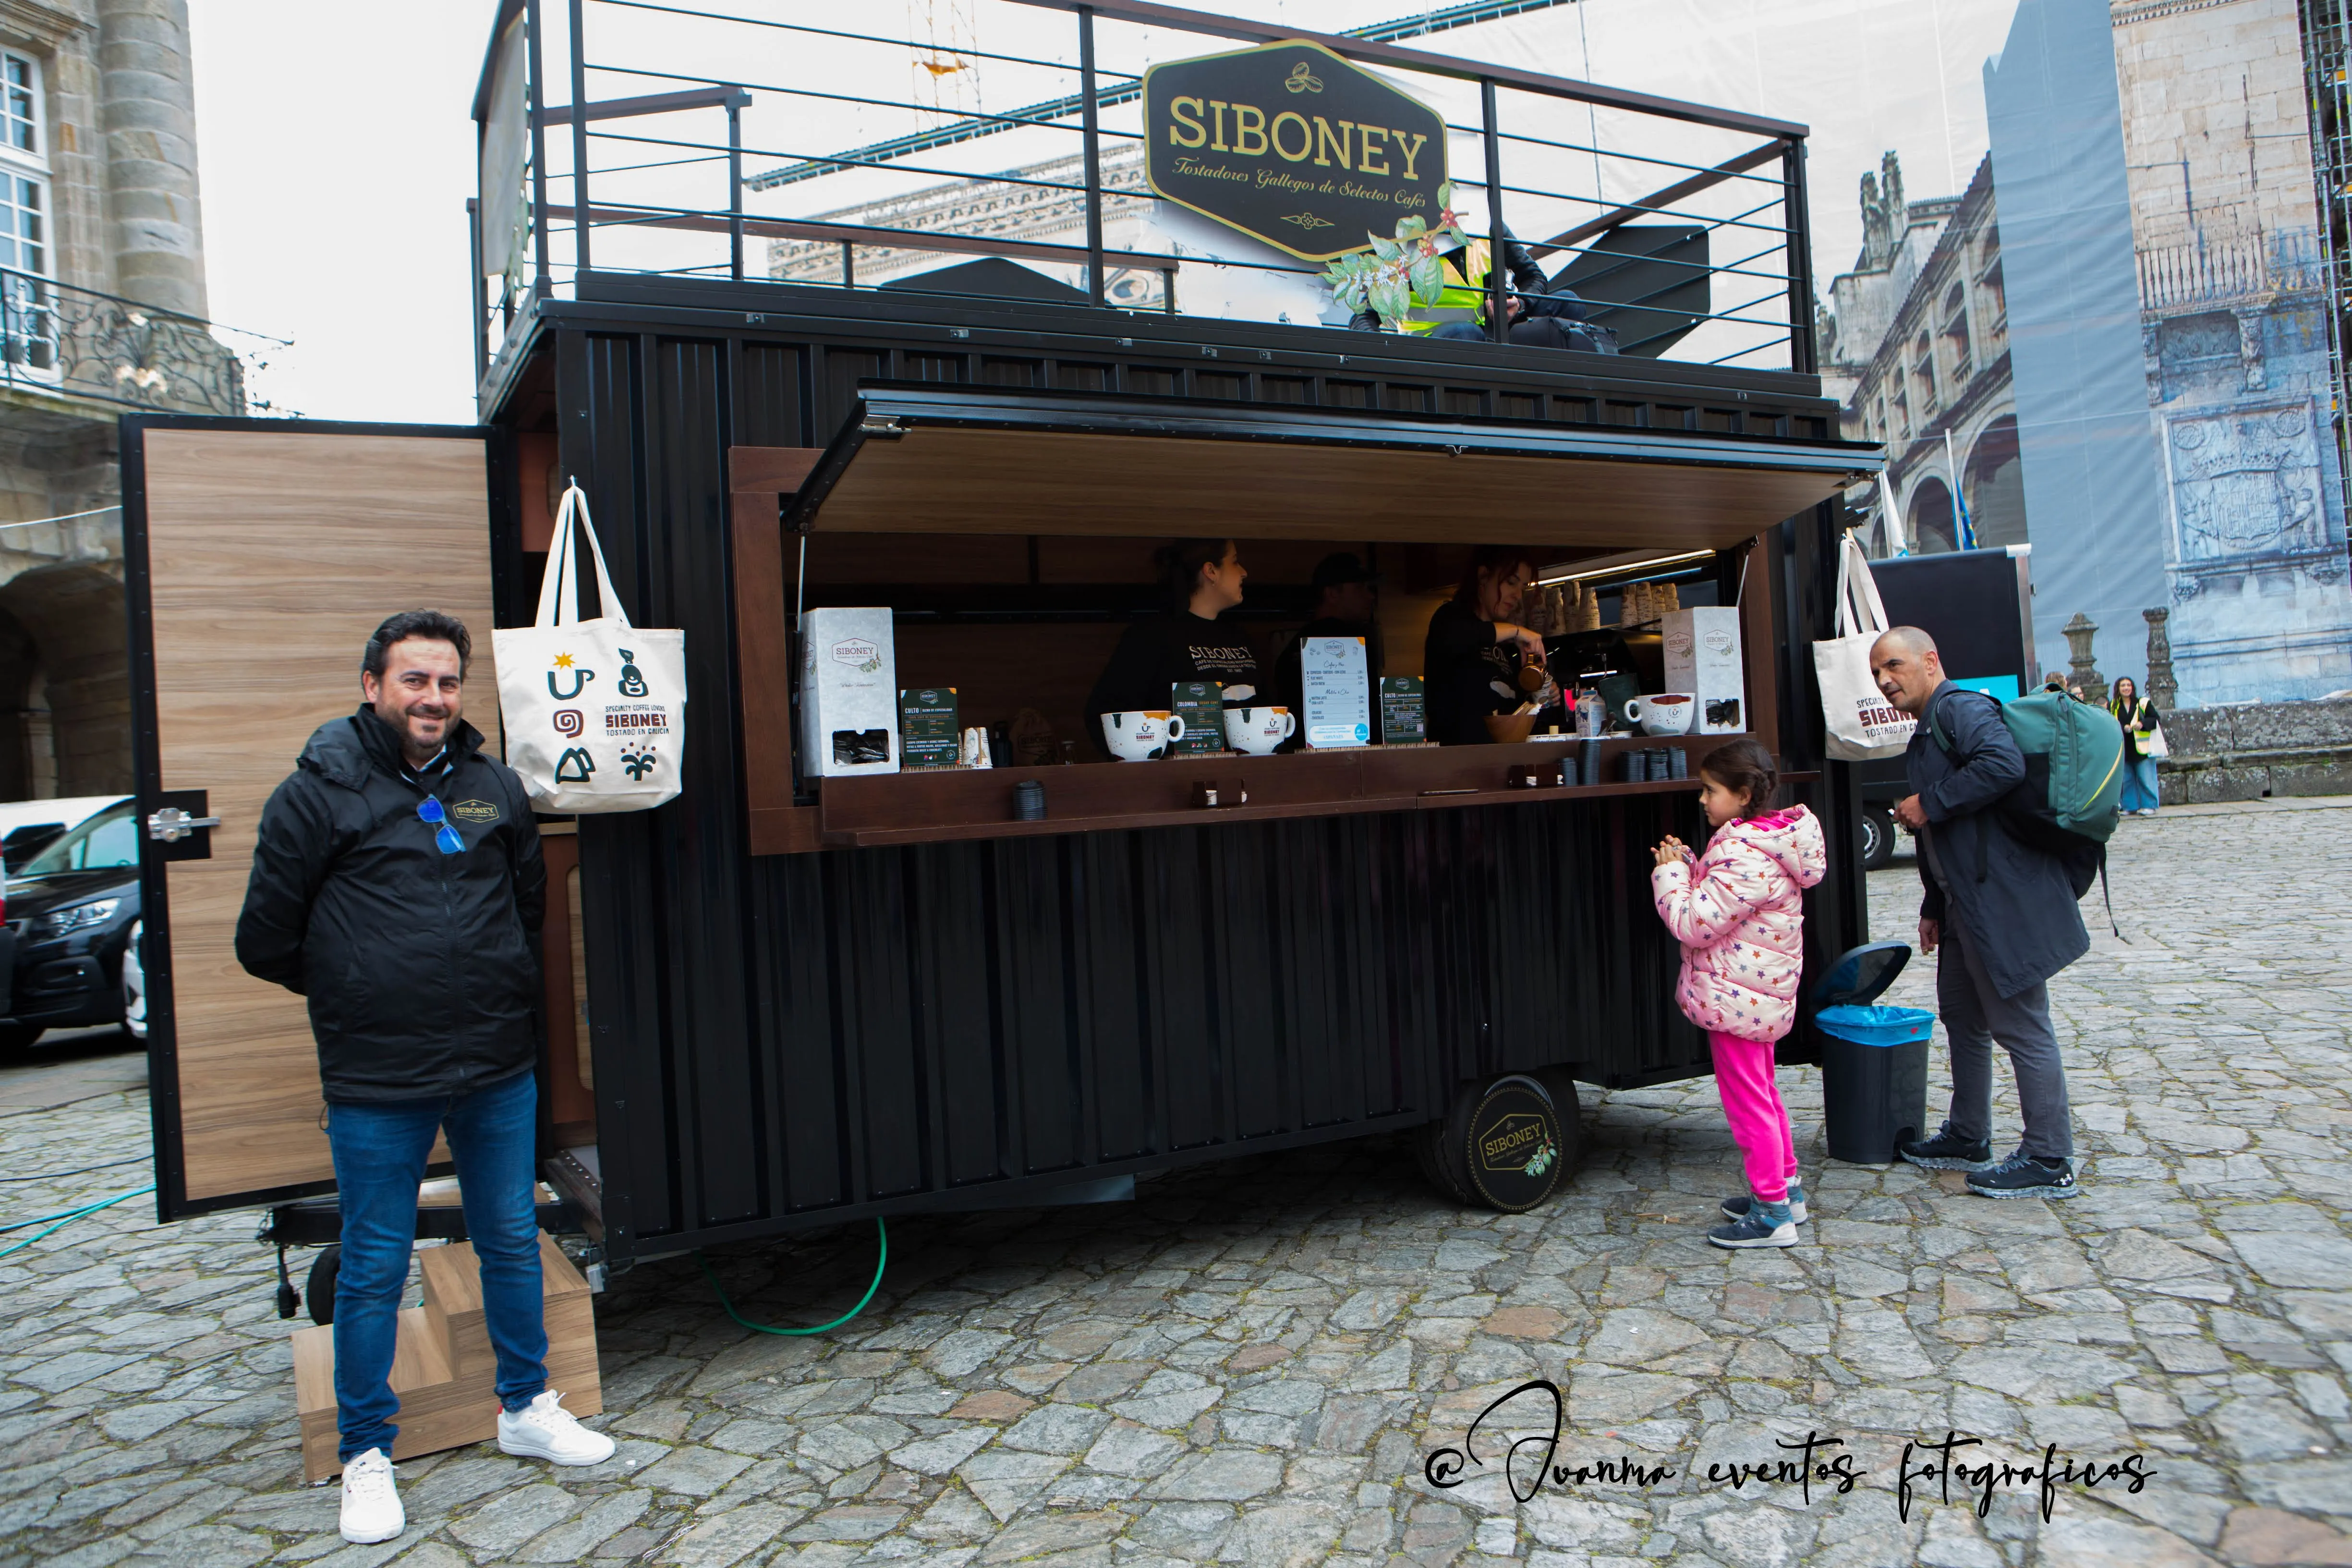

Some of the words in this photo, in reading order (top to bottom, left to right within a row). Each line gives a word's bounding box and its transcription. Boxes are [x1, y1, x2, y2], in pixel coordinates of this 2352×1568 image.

[1170, 96, 1427, 181] SIBONEY
[1173, 157, 1249, 182] Tostadores
[1255, 169, 1314, 193] Gallegos
[1319, 179, 1334, 194] de
[1340, 182, 1388, 201] Selectos
[1395, 189, 1425, 209] Cafés
[1189, 645, 1252, 659] SIBONEY
[606, 714, 667, 728] SIBONEY
[1865, 726, 1897, 738] TOSTADO
[1486, 1123, 1540, 1156] SIBONEY
